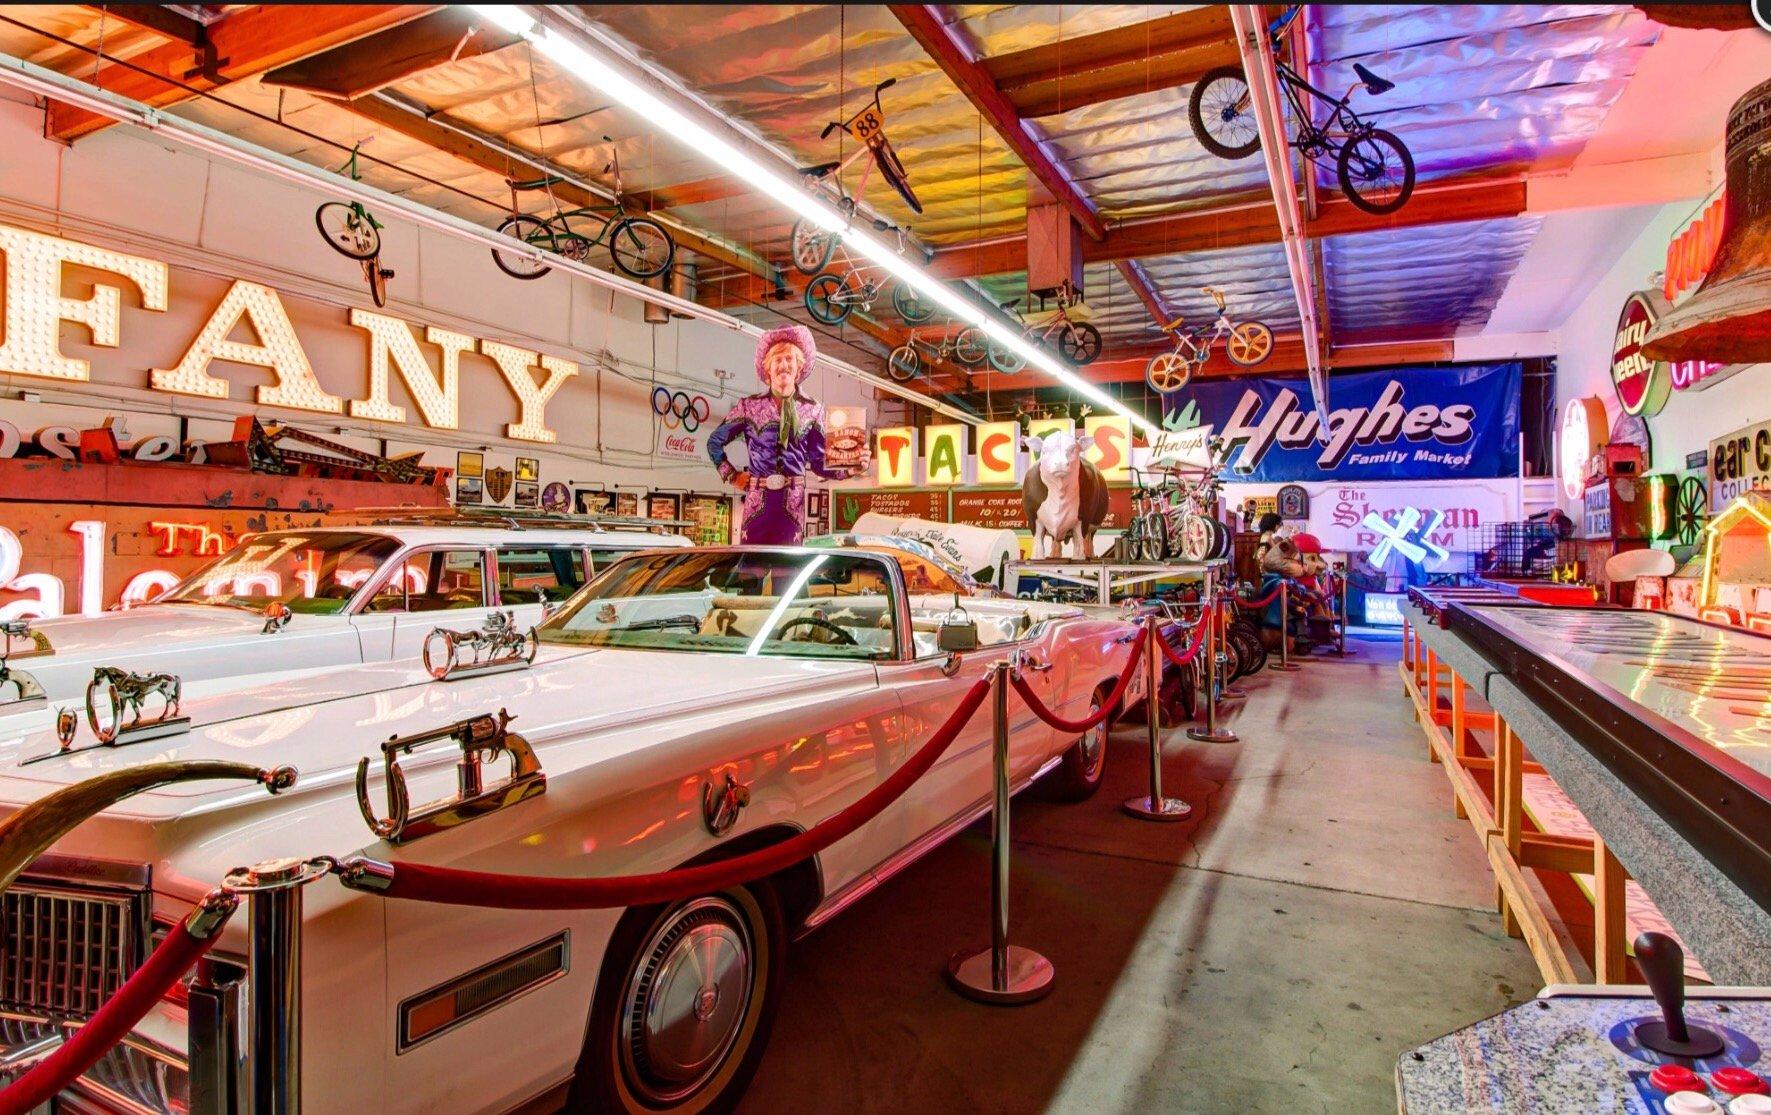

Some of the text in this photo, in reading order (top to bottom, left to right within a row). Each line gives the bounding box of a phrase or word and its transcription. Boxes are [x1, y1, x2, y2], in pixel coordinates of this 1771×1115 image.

[856, 113, 879, 137] 88
[1614, 318, 1647, 354] airy
[1214, 379, 1477, 476] Hughes
[1152, 433, 1203, 457] Henry's
[1348, 449, 1472, 465] Family Market
[1713, 436, 1751, 482] ear
[959, 498, 985, 506] ORANGE
[988, 498, 1006, 506] COKE
[1339, 490, 1366, 501] The
[998, 520, 1024, 528] COFFEE
[148, 520, 254, 556] Th
[1357, 532, 1454, 546] RM
